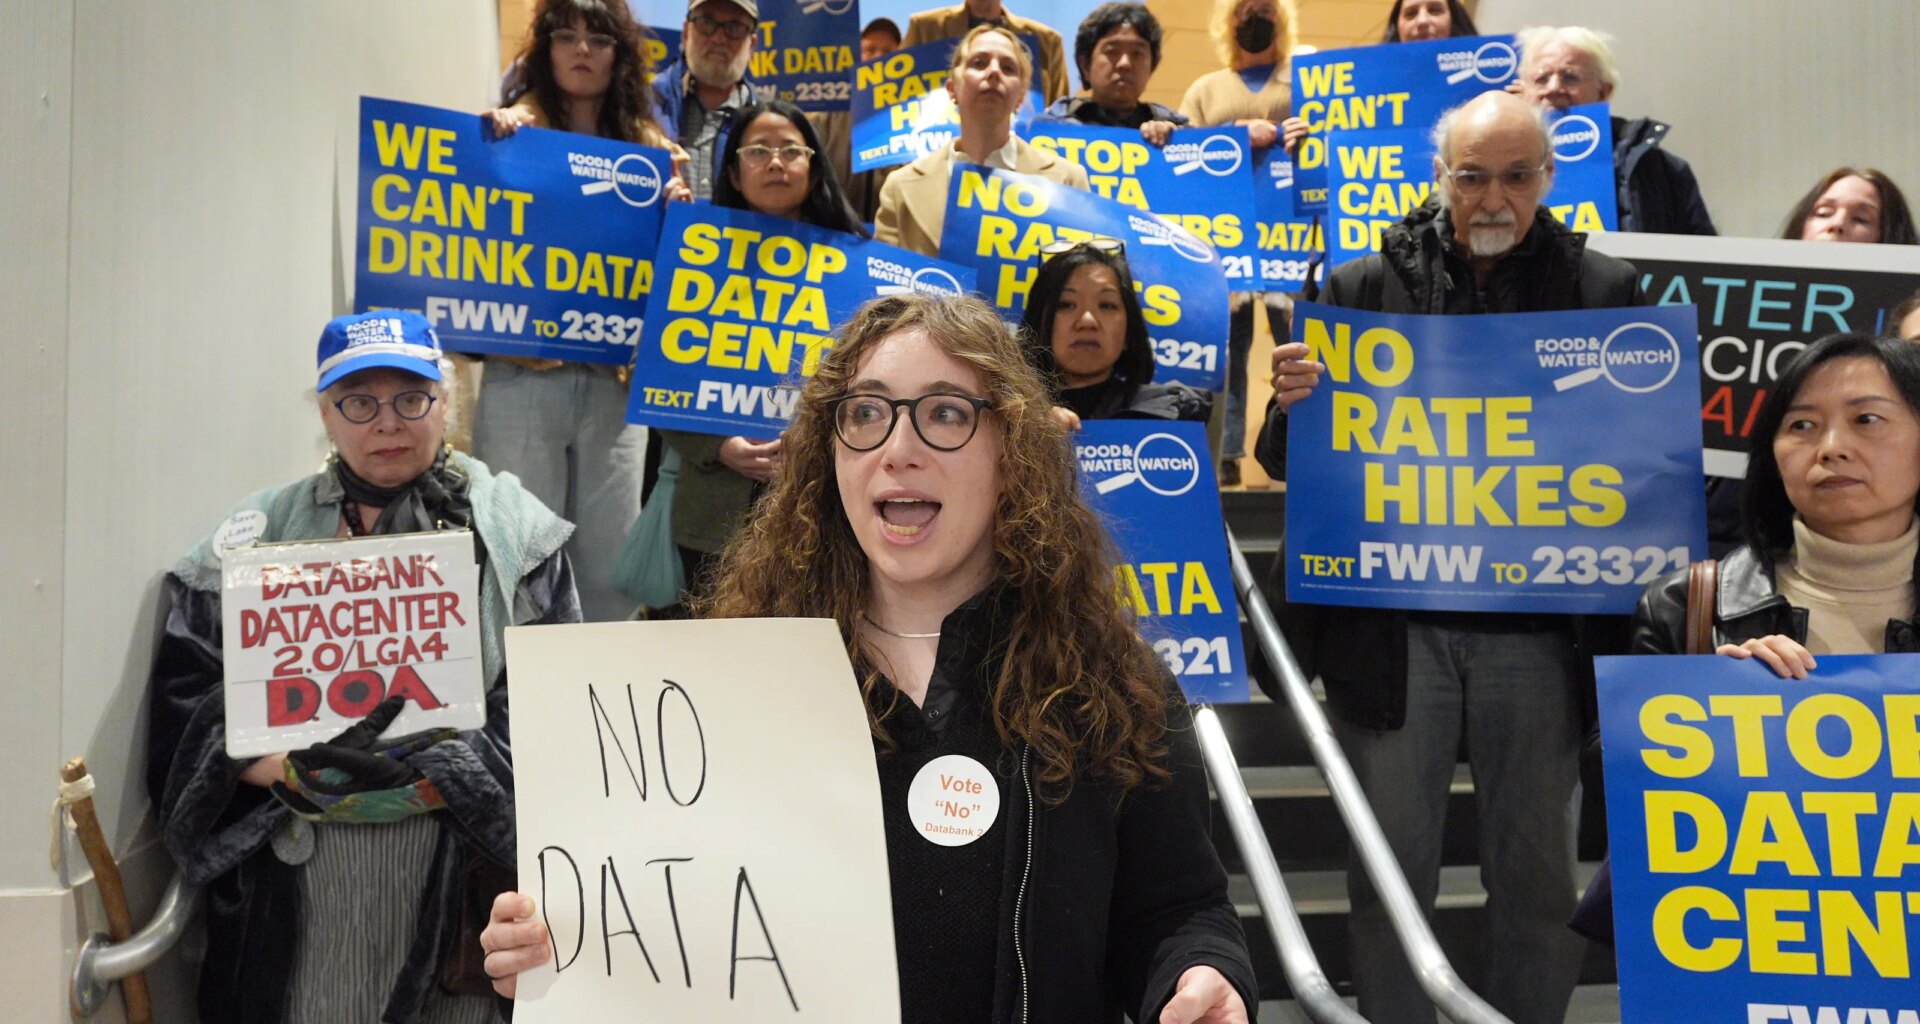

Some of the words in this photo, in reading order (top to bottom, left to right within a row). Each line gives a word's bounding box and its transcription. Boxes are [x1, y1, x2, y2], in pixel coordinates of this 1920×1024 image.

[784, 45, 855, 75] DATA
[856, 53, 915, 92] NO
[1298, 61, 1355, 98] WE
[796, 81, 853, 102] 2332
[873, 70, 953, 110] RAT
[1298, 92, 1410, 134] CAN'T
[372, 119, 458, 176] WE
[568, 152, 613, 170] FOOD&
[1336, 144, 1405, 180] WE
[570, 164, 613, 180] WATER
[616, 171, 657, 189] WATCH
[956, 169, 1051, 218] NO
[371, 173, 534, 236] CAN'T
[367, 225, 536, 289] DRINK
[545, 246, 655, 301] DATA
[679, 222, 848, 284] STOP
[867, 256, 913, 278] FOOD&
[868, 266, 911, 288] WATER
[426, 295, 529, 335] FWW
[532, 319, 560, 337] TO
[667, 267, 831, 332] DATA
[1640, 273, 1856, 334] ATER
[1303, 317, 1415, 388] NO
[1535, 337, 1601, 353] FOOD&
[1538, 352, 1599, 368] WATER
[1606, 349, 1673, 366] WATCH
[643, 386, 694, 409] TEXT
[1332, 390, 1536, 458] RATE
[1075, 444, 1134, 459] FOOD&
[1080, 458, 1133, 472] WATER
[1138, 457, 1194, 471] WATCH
[1364, 461, 1628, 528] HIKES
[261, 554, 445, 601] DATABANK
[1300, 553, 1356, 578] TEXT
[1359, 541, 1484, 583] FWW
[1491, 562, 1529, 585] TO
[241, 591, 467, 649] DATACENTER
[272, 631, 449, 678] 2.0/LGA4
[588, 678, 707, 807] NO
[940, 774, 983, 794] Vote
[924, 822, 974, 837] Databank
[537, 845, 800, 1012] DATA
[1652, 885, 1920, 979] CEN
